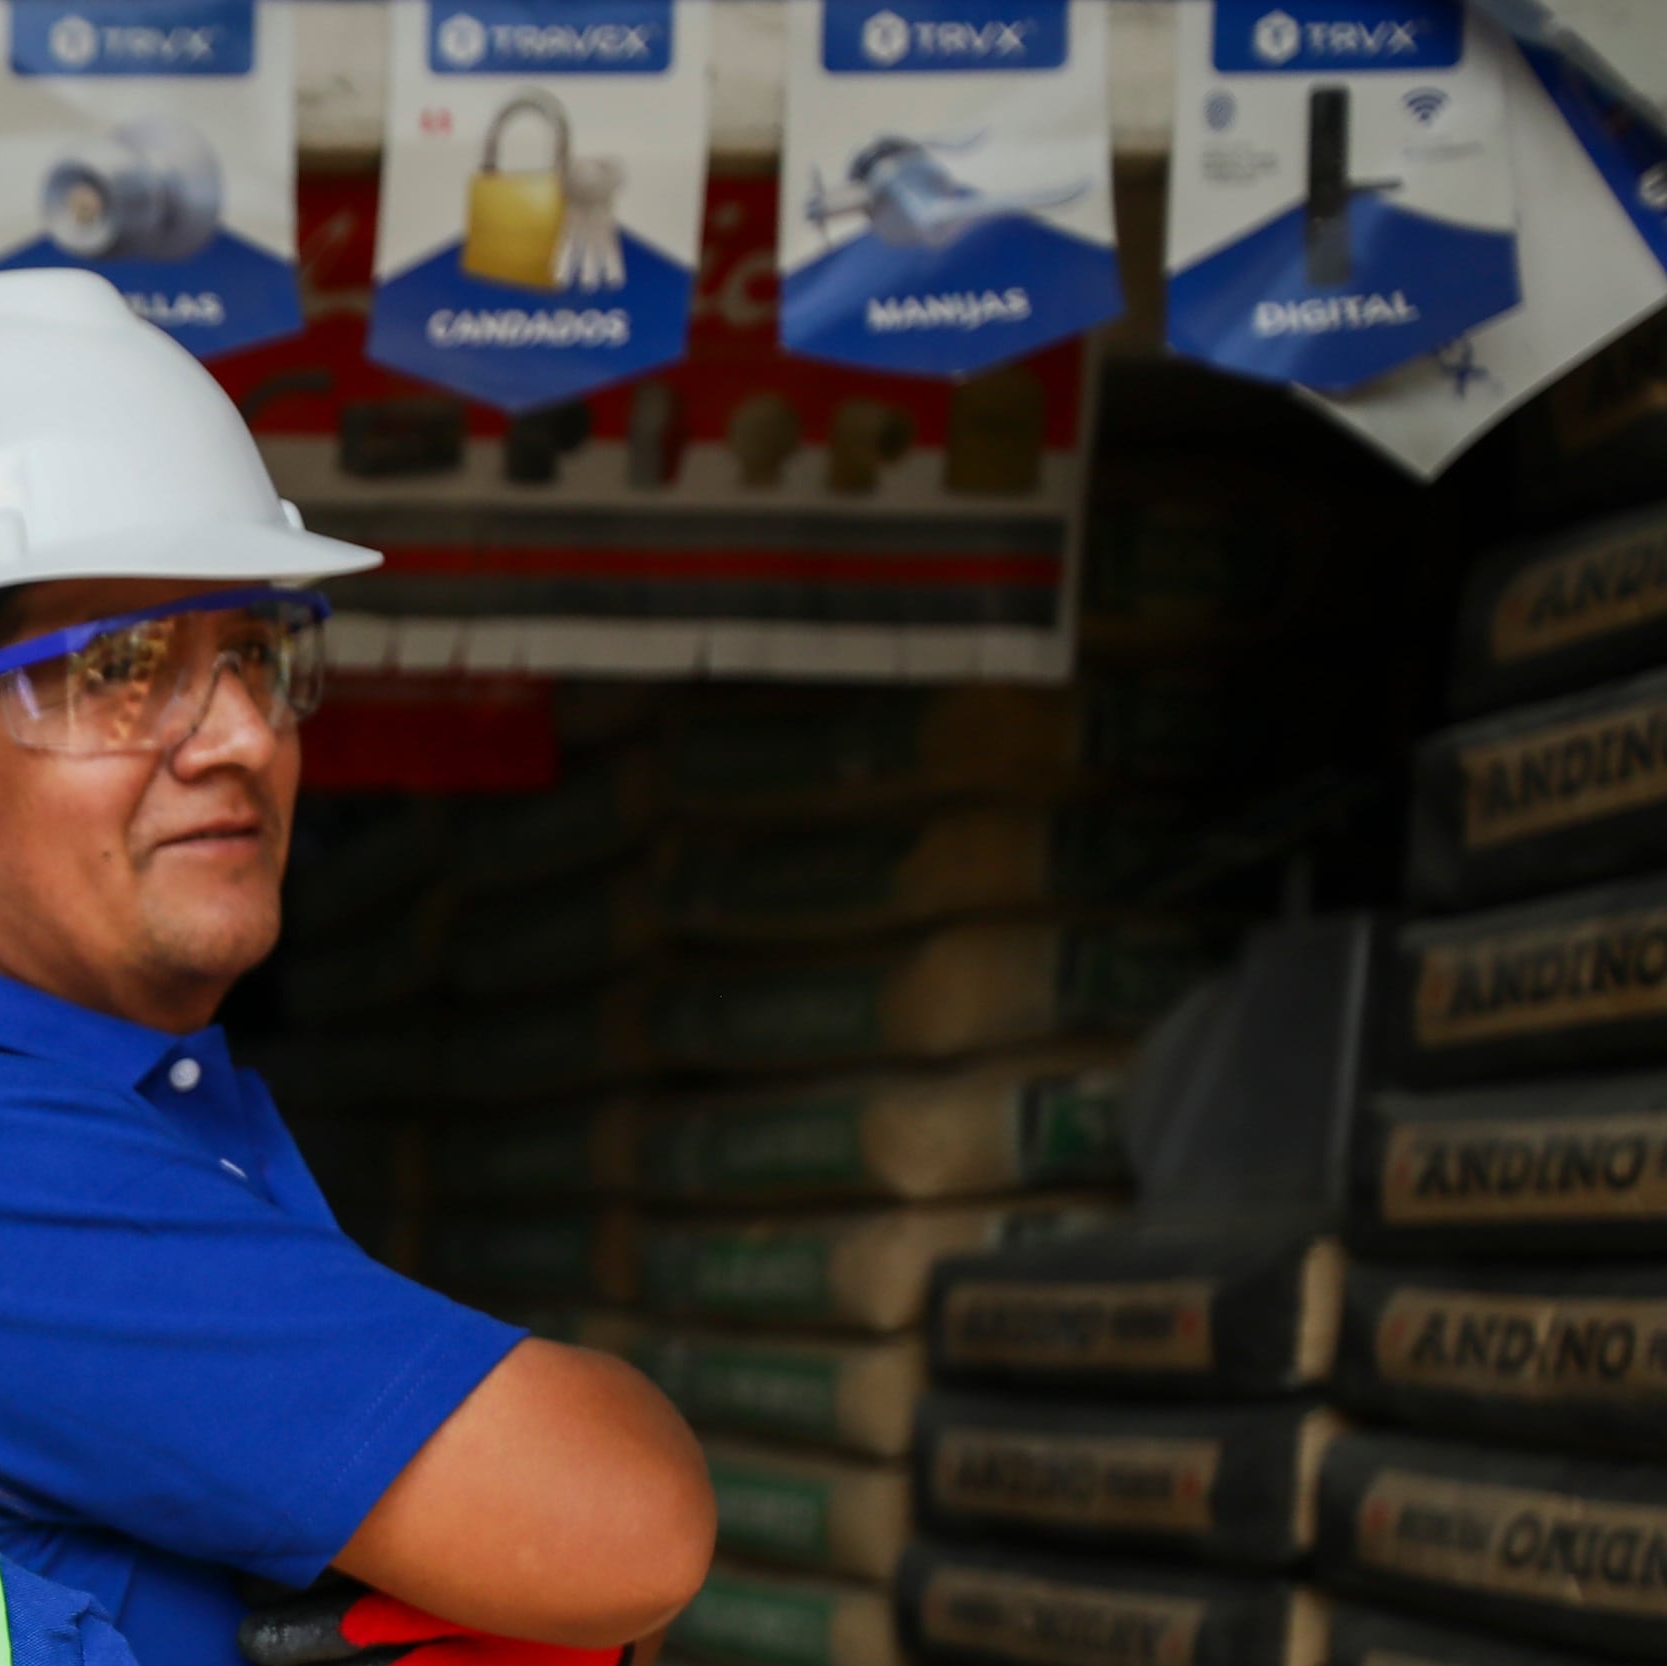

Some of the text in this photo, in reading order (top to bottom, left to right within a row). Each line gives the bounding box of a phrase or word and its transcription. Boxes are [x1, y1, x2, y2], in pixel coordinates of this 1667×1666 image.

[425, 308, 630, 348] CANDADOS
[1251, 289, 1420, 338] DIGITAL
[1415, 1132, 1649, 1197] ANDINO
